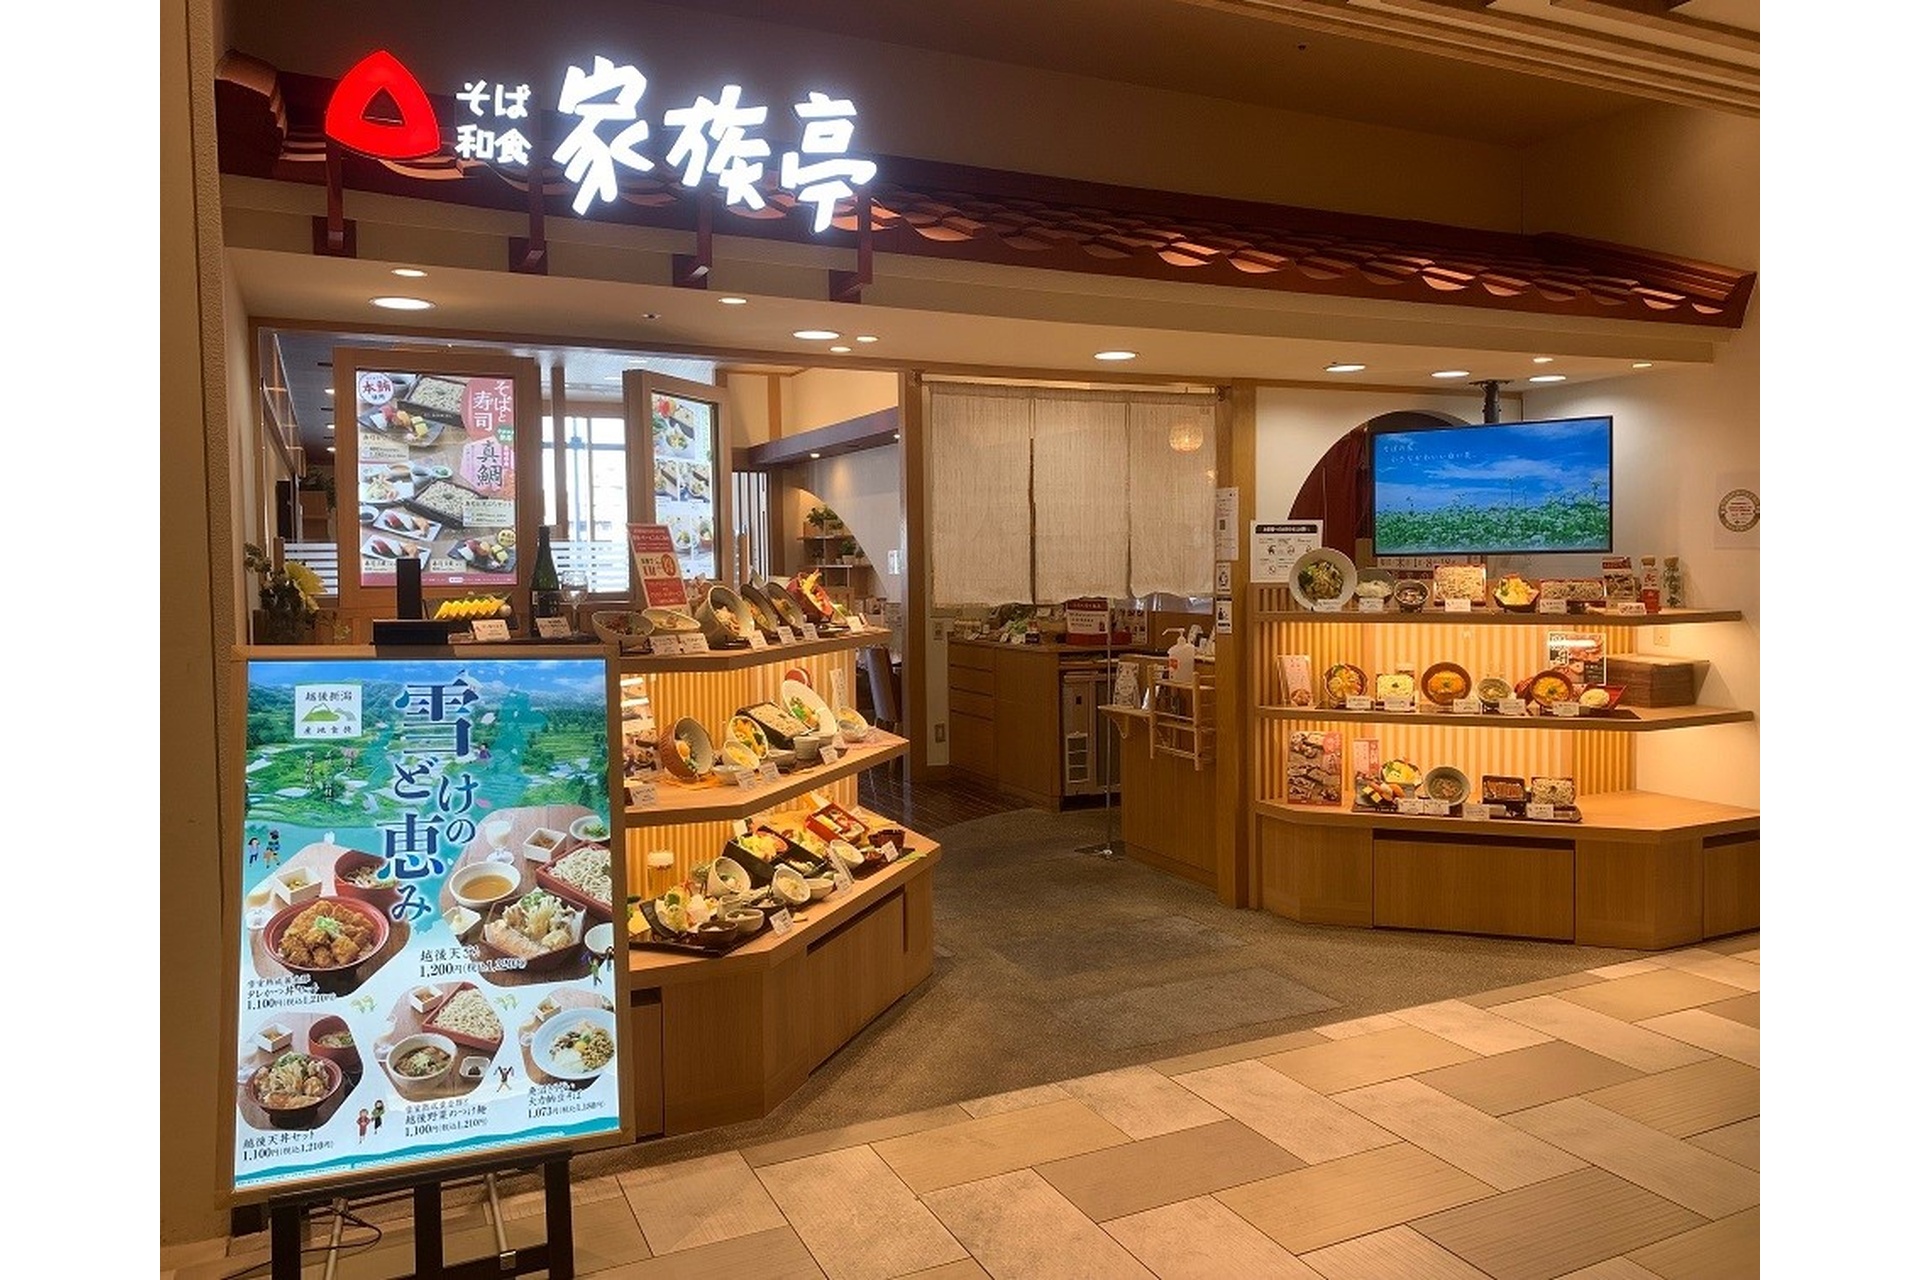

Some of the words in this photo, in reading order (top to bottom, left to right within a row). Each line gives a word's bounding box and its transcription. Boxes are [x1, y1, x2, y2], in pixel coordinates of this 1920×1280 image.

[455, 79, 532, 119] そば
[455, 124, 532, 167] 和食
[552, 55, 877, 233] 家族亭
[473, 390, 494, 431] 寿司
[493, 380, 512, 423] そばと
[477, 439, 503, 487] 真鯛
